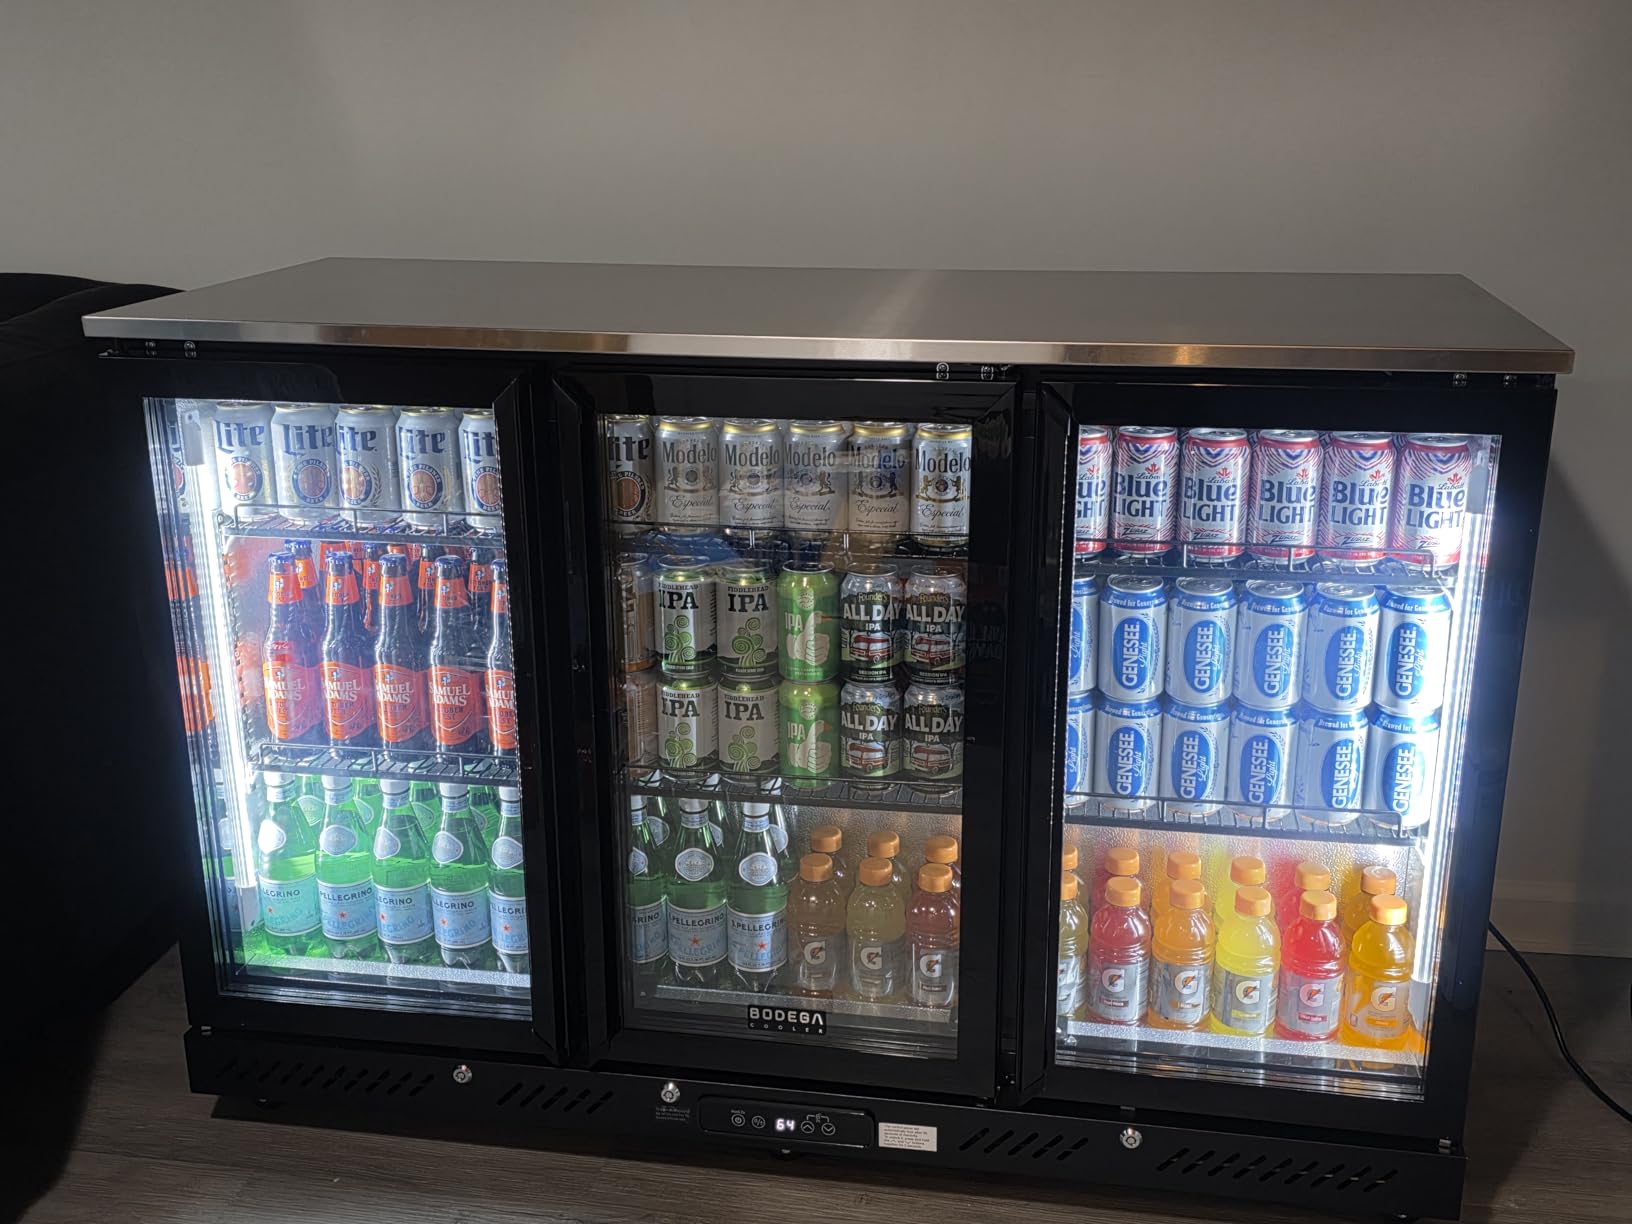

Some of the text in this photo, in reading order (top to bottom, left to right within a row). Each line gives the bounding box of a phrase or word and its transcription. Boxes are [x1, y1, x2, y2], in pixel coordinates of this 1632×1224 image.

[283, 424, 333, 456] Lite
[462, 430, 496, 463] Lit
[662, 441, 717, 464] Modelo
[725, 444, 780, 467] Modelo
[850, 445, 905, 470] Modelo
[915, 449, 971, 474] Modelo
[1077, 480, 1106, 498] ue
[1114, 472, 1168, 498] Blue
[1183, 477, 1238, 502] Blue
[1260, 479, 1316, 504] Blue
[1332, 480, 1388, 506] Blue
[1113, 496, 1167, 517] LIGHT
[1407, 483, 1465, 509] Blue
[920, 504, 963, 521] Especial
[1076, 499, 1105, 518] GHT
[1182, 501, 1237, 522] LIGHT
[1259, 503, 1315, 524] LIGHT
[1330, 505, 1386, 526] LIGHT
[1405, 508, 1463, 529] LIGHT
[659, 589, 699, 610] IPA
[728, 585, 769, 593] FIDDLEHEAD
[728, 593, 769, 612] IPA
[843, 603, 902, 621] ALL DAY
[785, 612, 804, 631] IPA
[906, 604, 965, 623] ALL DAY
[865, 623, 881, 631] IPA
[926, 624, 941, 633] IPA
[1122, 624, 1140, 687] GENESEE
[1138, 642, 1148, 668] Light
[1194, 627, 1213, 689] GENESEE
[1264, 631, 1284, 694] GENESEE
[1336, 632, 1357, 697] GENESEE
[1395, 628, 1417, 696] GENESEE
[325, 680, 361, 691] MUEL
[326, 689, 358, 701] DAMS
[377, 693, 411, 704] DAMS
[662, 697, 701, 717] IPA
[724, 701, 765, 720] IPA
[787, 721, 806, 740] IPA
[841, 712, 898, 732] ALL DAY
[904, 714, 963, 733] ALL DAY
[859, 732, 873, 741] IPA
[925, 734, 940, 743] IPA
[1116, 732, 1135, 795] GENESEE
[1132, 752, 1142, 777] Light
[1180, 736, 1199, 798] GENESEE
[1196, 756, 1207, 781] Light
[1248, 740, 1268, 804] GENESEE
[1267, 760, 1278, 786] Light
[1332, 743, 1352, 809] GENESEE
[1391, 747, 1414, 813] GENESEE
[749, 1007, 824, 1025] BODEGA
[750, 1022, 823, 1034] COOLER
[776, 1118, 796, 1132] 64
